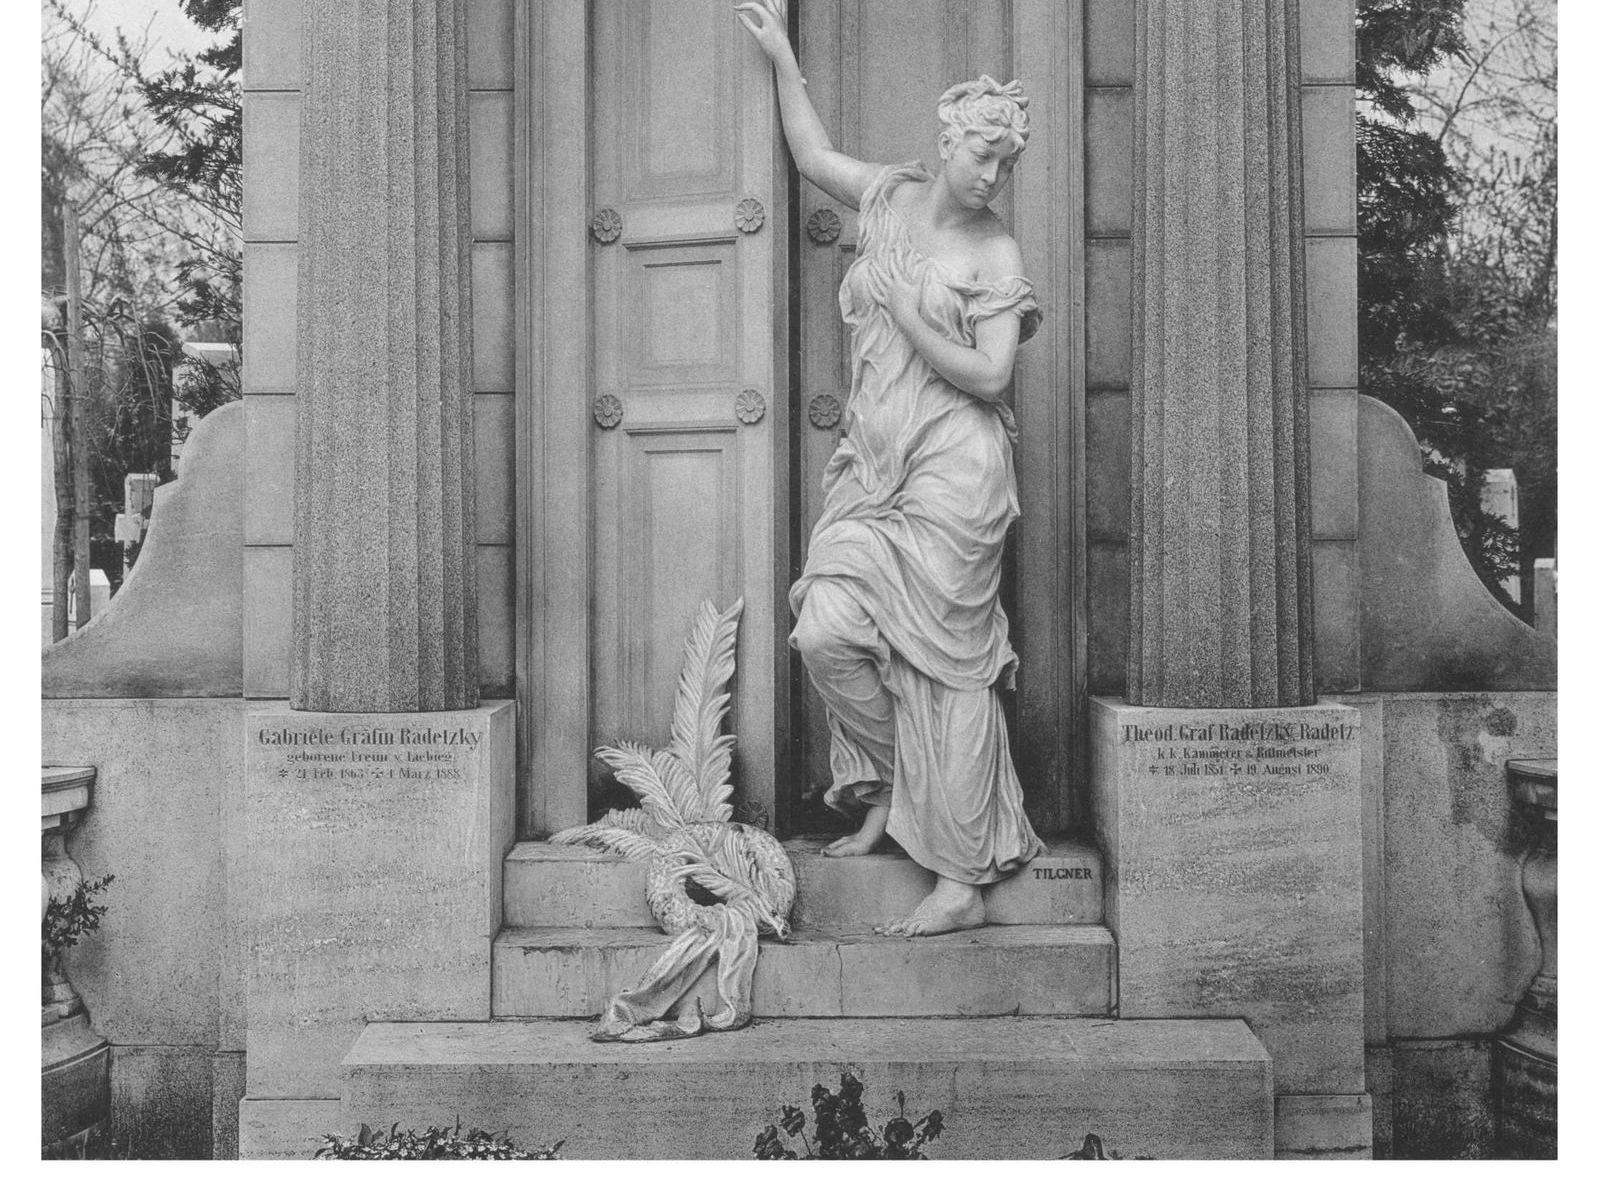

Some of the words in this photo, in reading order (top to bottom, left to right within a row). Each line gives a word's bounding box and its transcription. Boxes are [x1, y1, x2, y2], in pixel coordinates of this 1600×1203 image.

[258, 727, 334, 746] Gabriele
[400, 727, 484, 751] Radetzky
[1033, 867, 1093, 880] TILGNER
